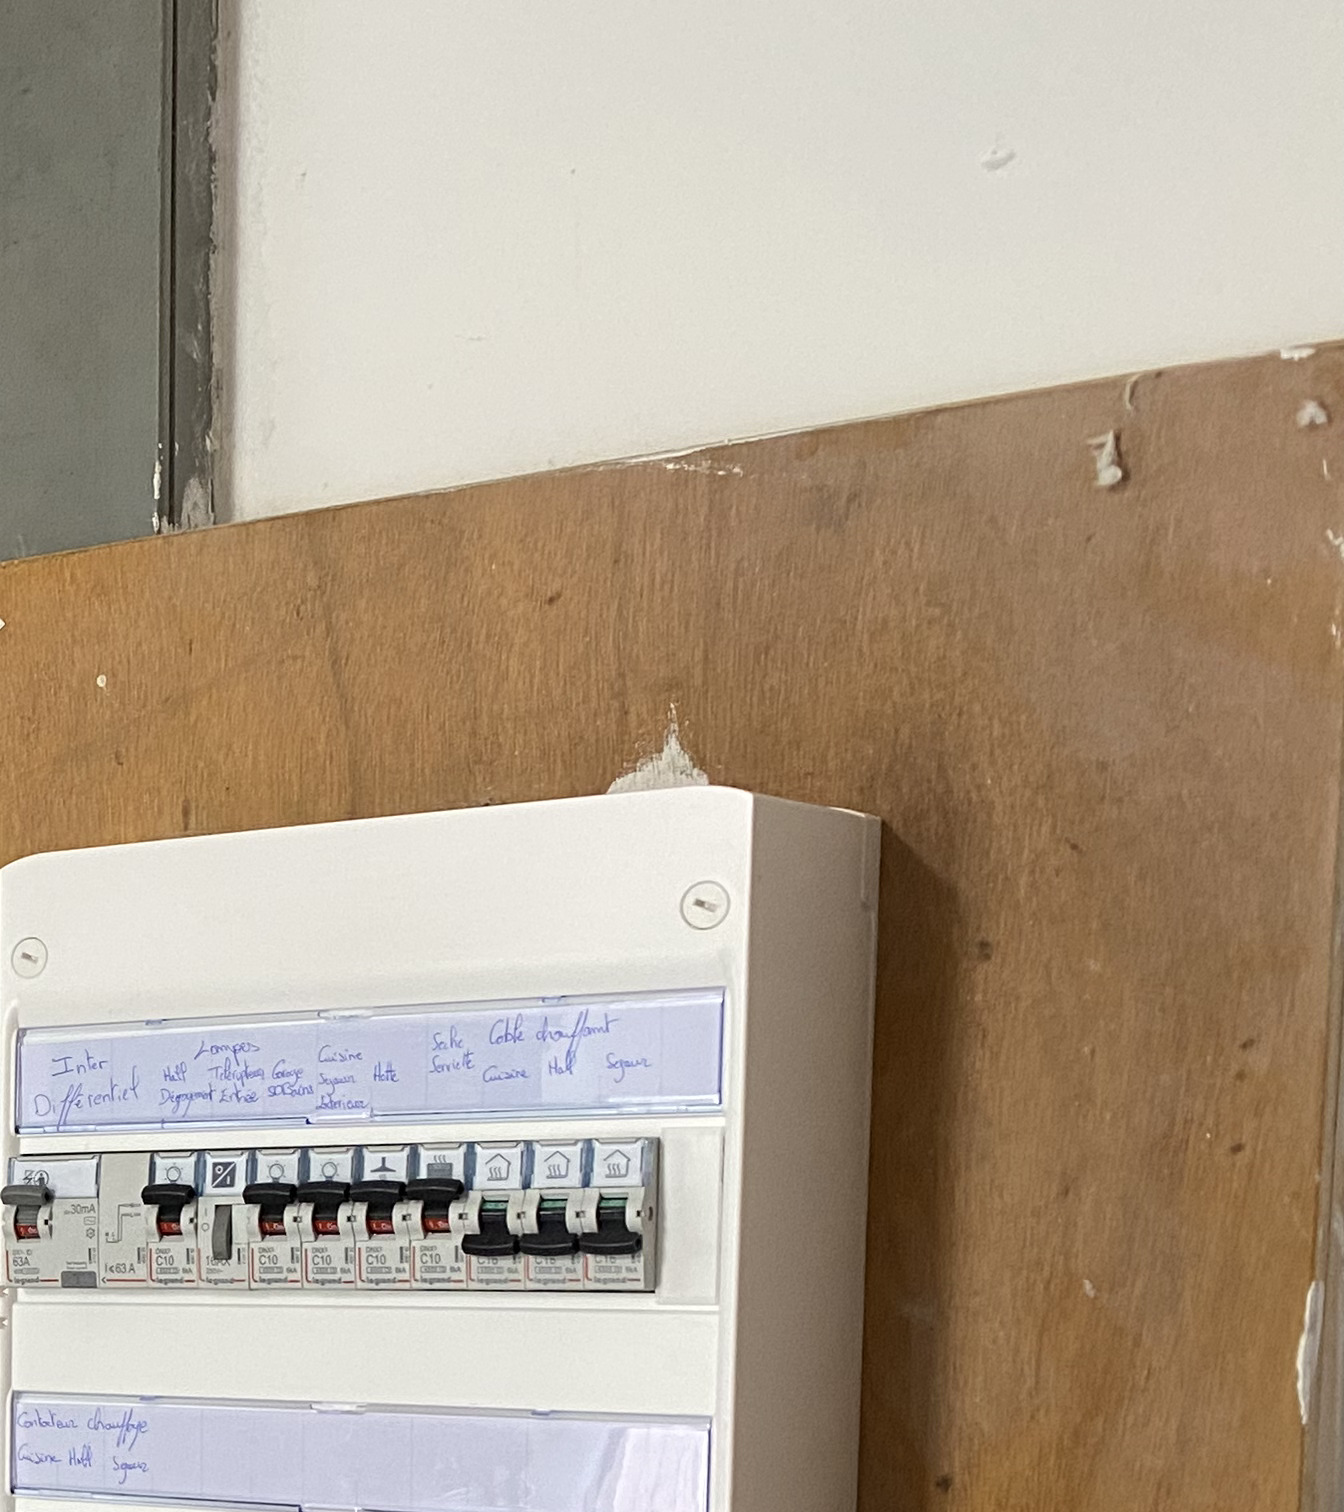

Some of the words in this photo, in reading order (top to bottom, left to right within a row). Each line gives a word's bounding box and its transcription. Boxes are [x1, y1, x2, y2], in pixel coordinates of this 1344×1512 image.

[52, 1049, 108, 1077] Inter
[318, 1044, 363, 1064] Cuisine
[374, 1064, 400, 1083] Hotte
[482, 1065, 529, 1083] Cuisine
[156, 1255, 174, 1266] C10
[258, 1254, 278, 1266] C10
[312, 1255, 332, 1266] C10
[366, 1254, 386, 1266] C10
[420, 1254, 442, 1264] C10
